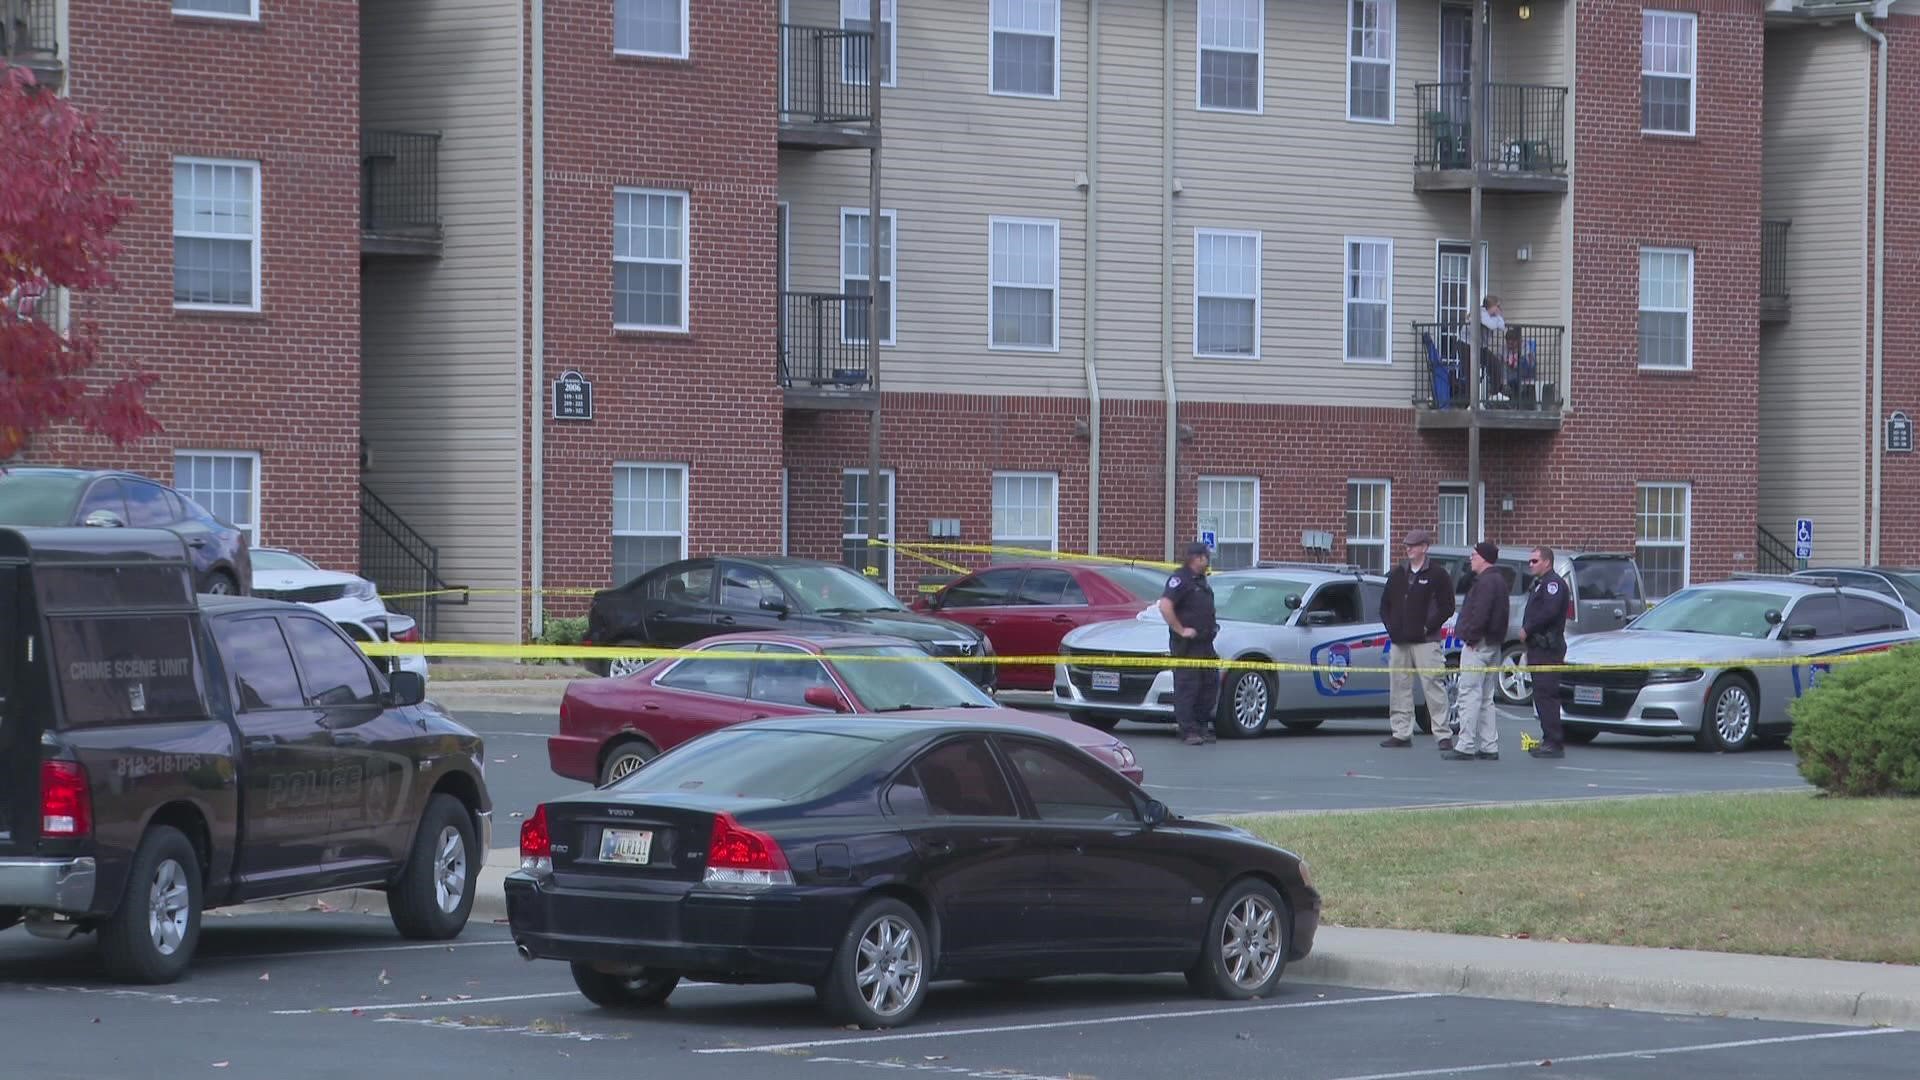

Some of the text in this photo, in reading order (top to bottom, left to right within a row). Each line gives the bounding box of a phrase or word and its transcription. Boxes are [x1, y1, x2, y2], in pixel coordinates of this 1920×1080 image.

[565, 383, 582, 391] 2006
[70, 657, 189, 680] CRIME SCENE UNIT
[266, 764, 363, 810] POLICE
[608, 808, 634, 816] VOLVO
